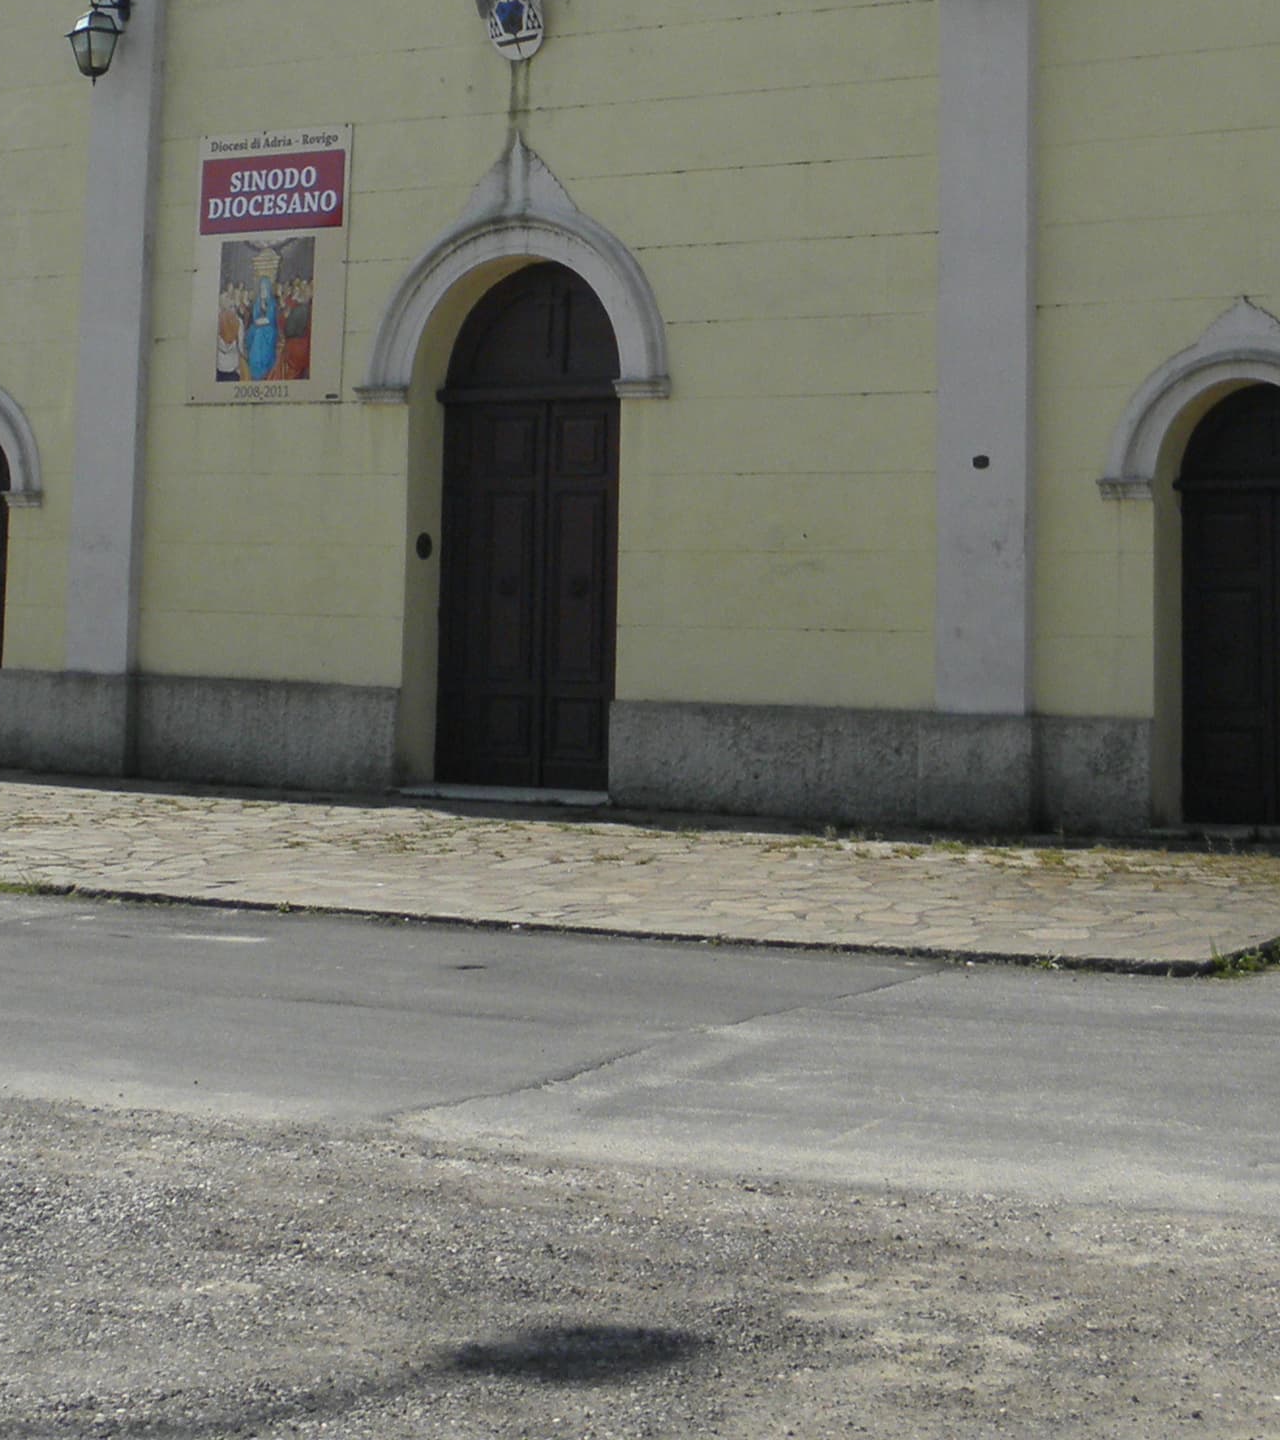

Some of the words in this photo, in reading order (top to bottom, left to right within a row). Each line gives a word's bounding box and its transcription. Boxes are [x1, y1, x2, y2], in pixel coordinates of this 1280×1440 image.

[211, 139, 248, 152] Diocesi
[251, 138, 260, 149] di
[263, 136, 292, 148] Adria
[302, 133, 338, 147] Rovigo
[230, 166, 317, 192] SINODO
[208, 190, 337, 219] DIOCESANO
